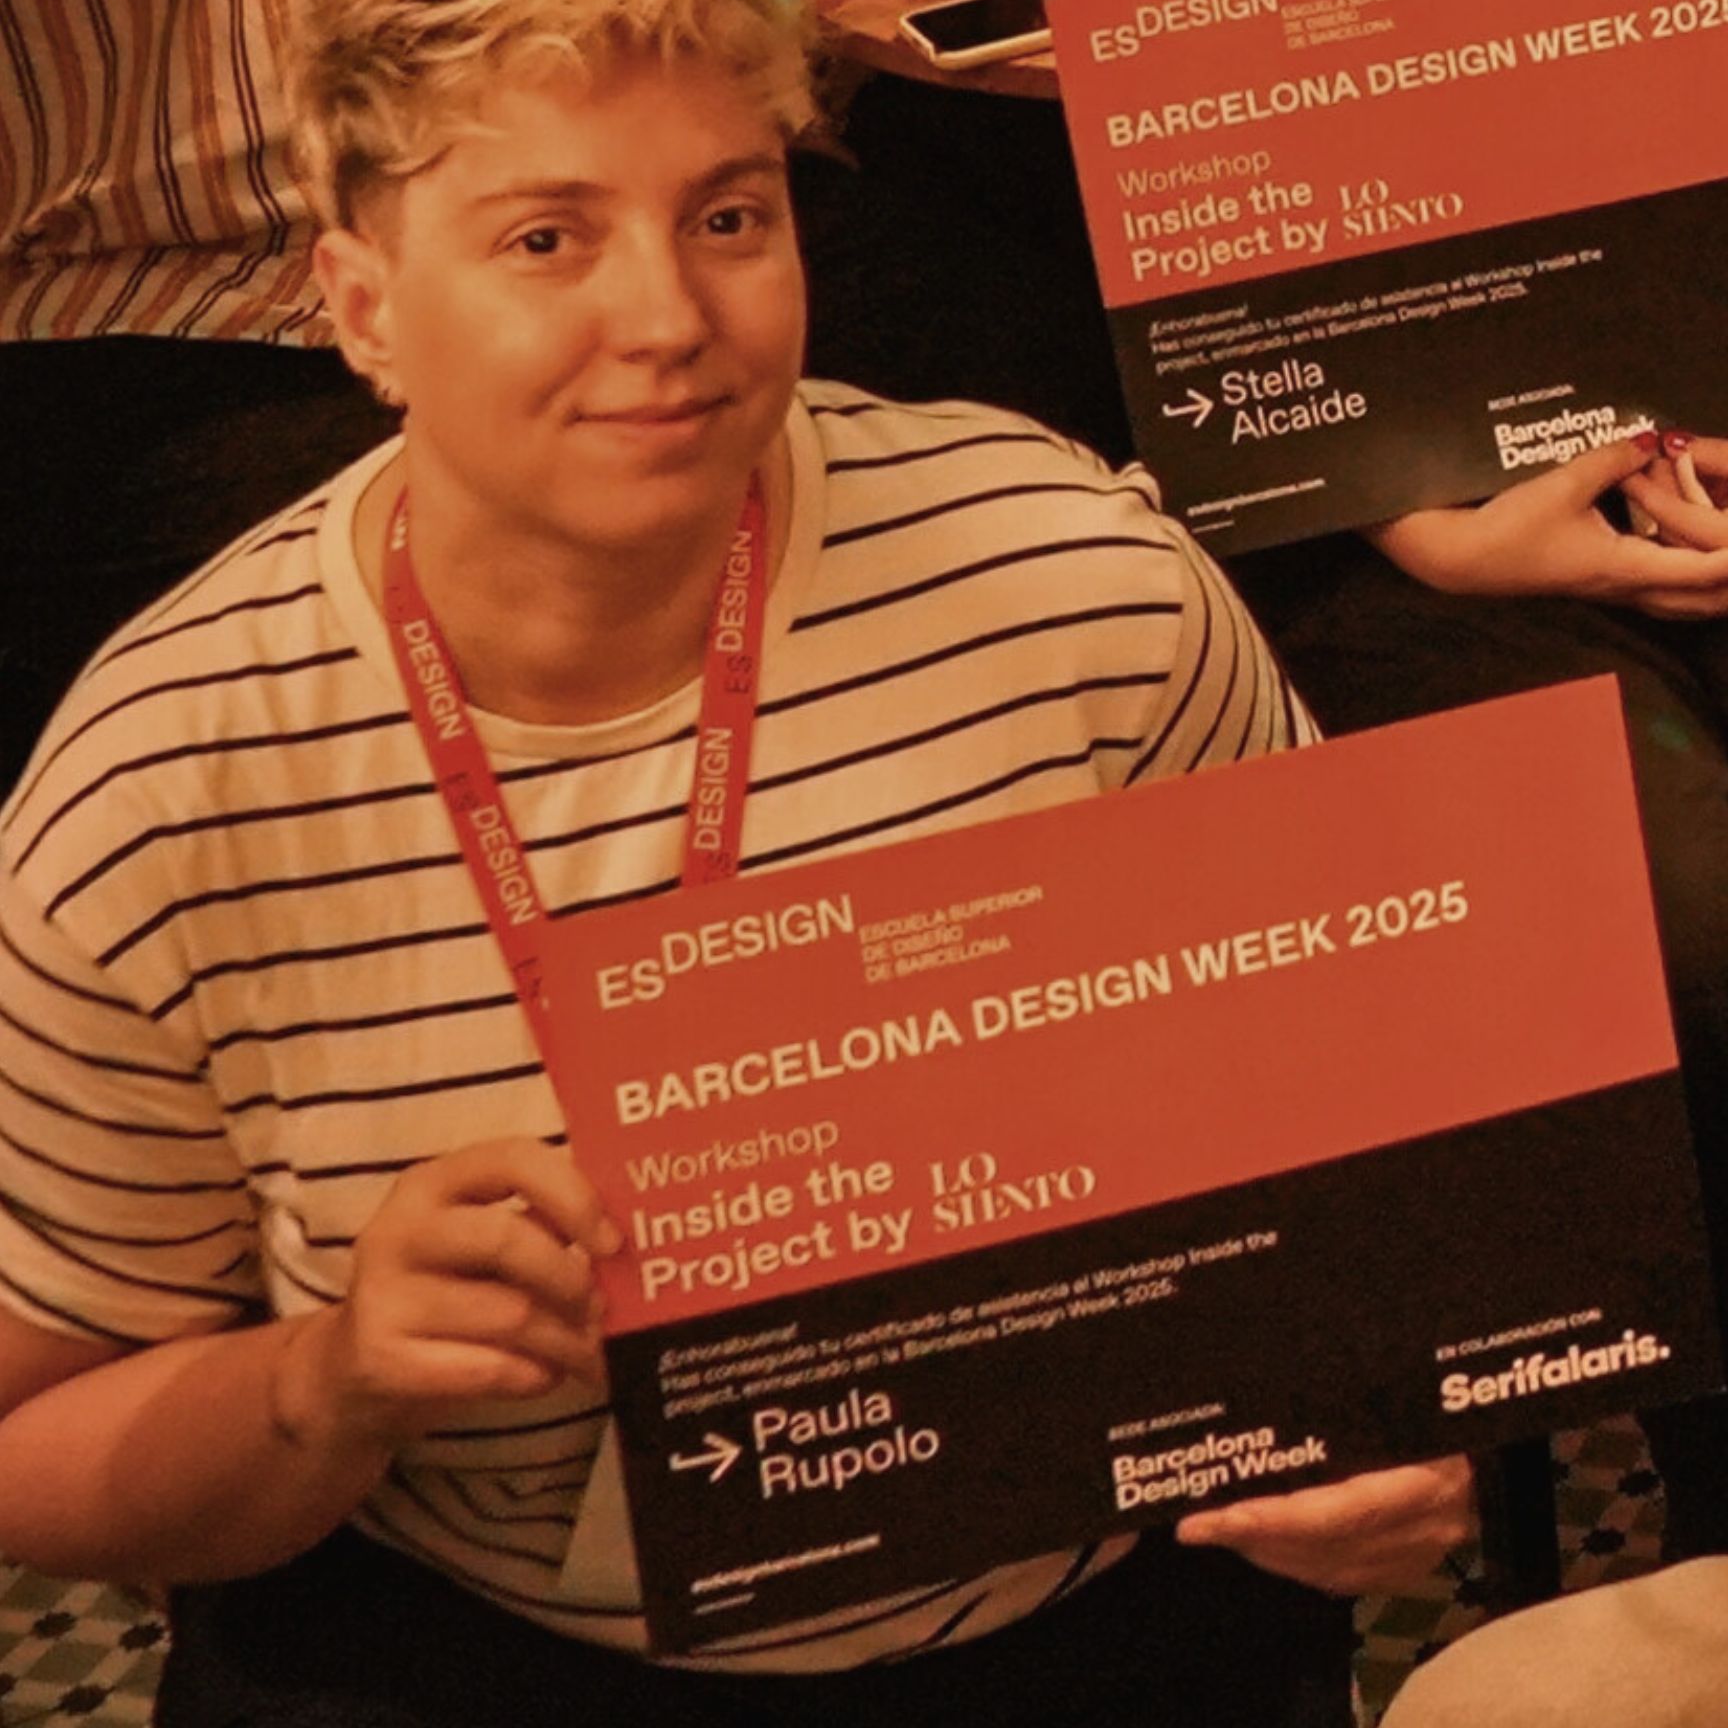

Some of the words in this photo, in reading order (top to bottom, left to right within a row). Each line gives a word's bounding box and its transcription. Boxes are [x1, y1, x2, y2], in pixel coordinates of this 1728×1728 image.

[1106, 71, 1361, 147] BARCELONA
[1366, 37, 1517, 95] DESIGN
[1523, 12, 1642, 62] WEEK
[1221, 359, 1325, 406] Stella
[1231, 389, 1367, 444] Alcaide
[596, 894, 855, 1010] ESDESIGN
[615, 1008, 963, 1125] BARCELONA
[972, 954, 1172, 1040] DESIGN
[1180, 914, 1337, 986] WEEK
[1346, 880, 1468, 948] 2025
[1440, 1329, 1671, 1412] Serifalaris.
[752, 1388, 892, 1452] Paula
[759, 1425, 940, 1499] Rupolo
